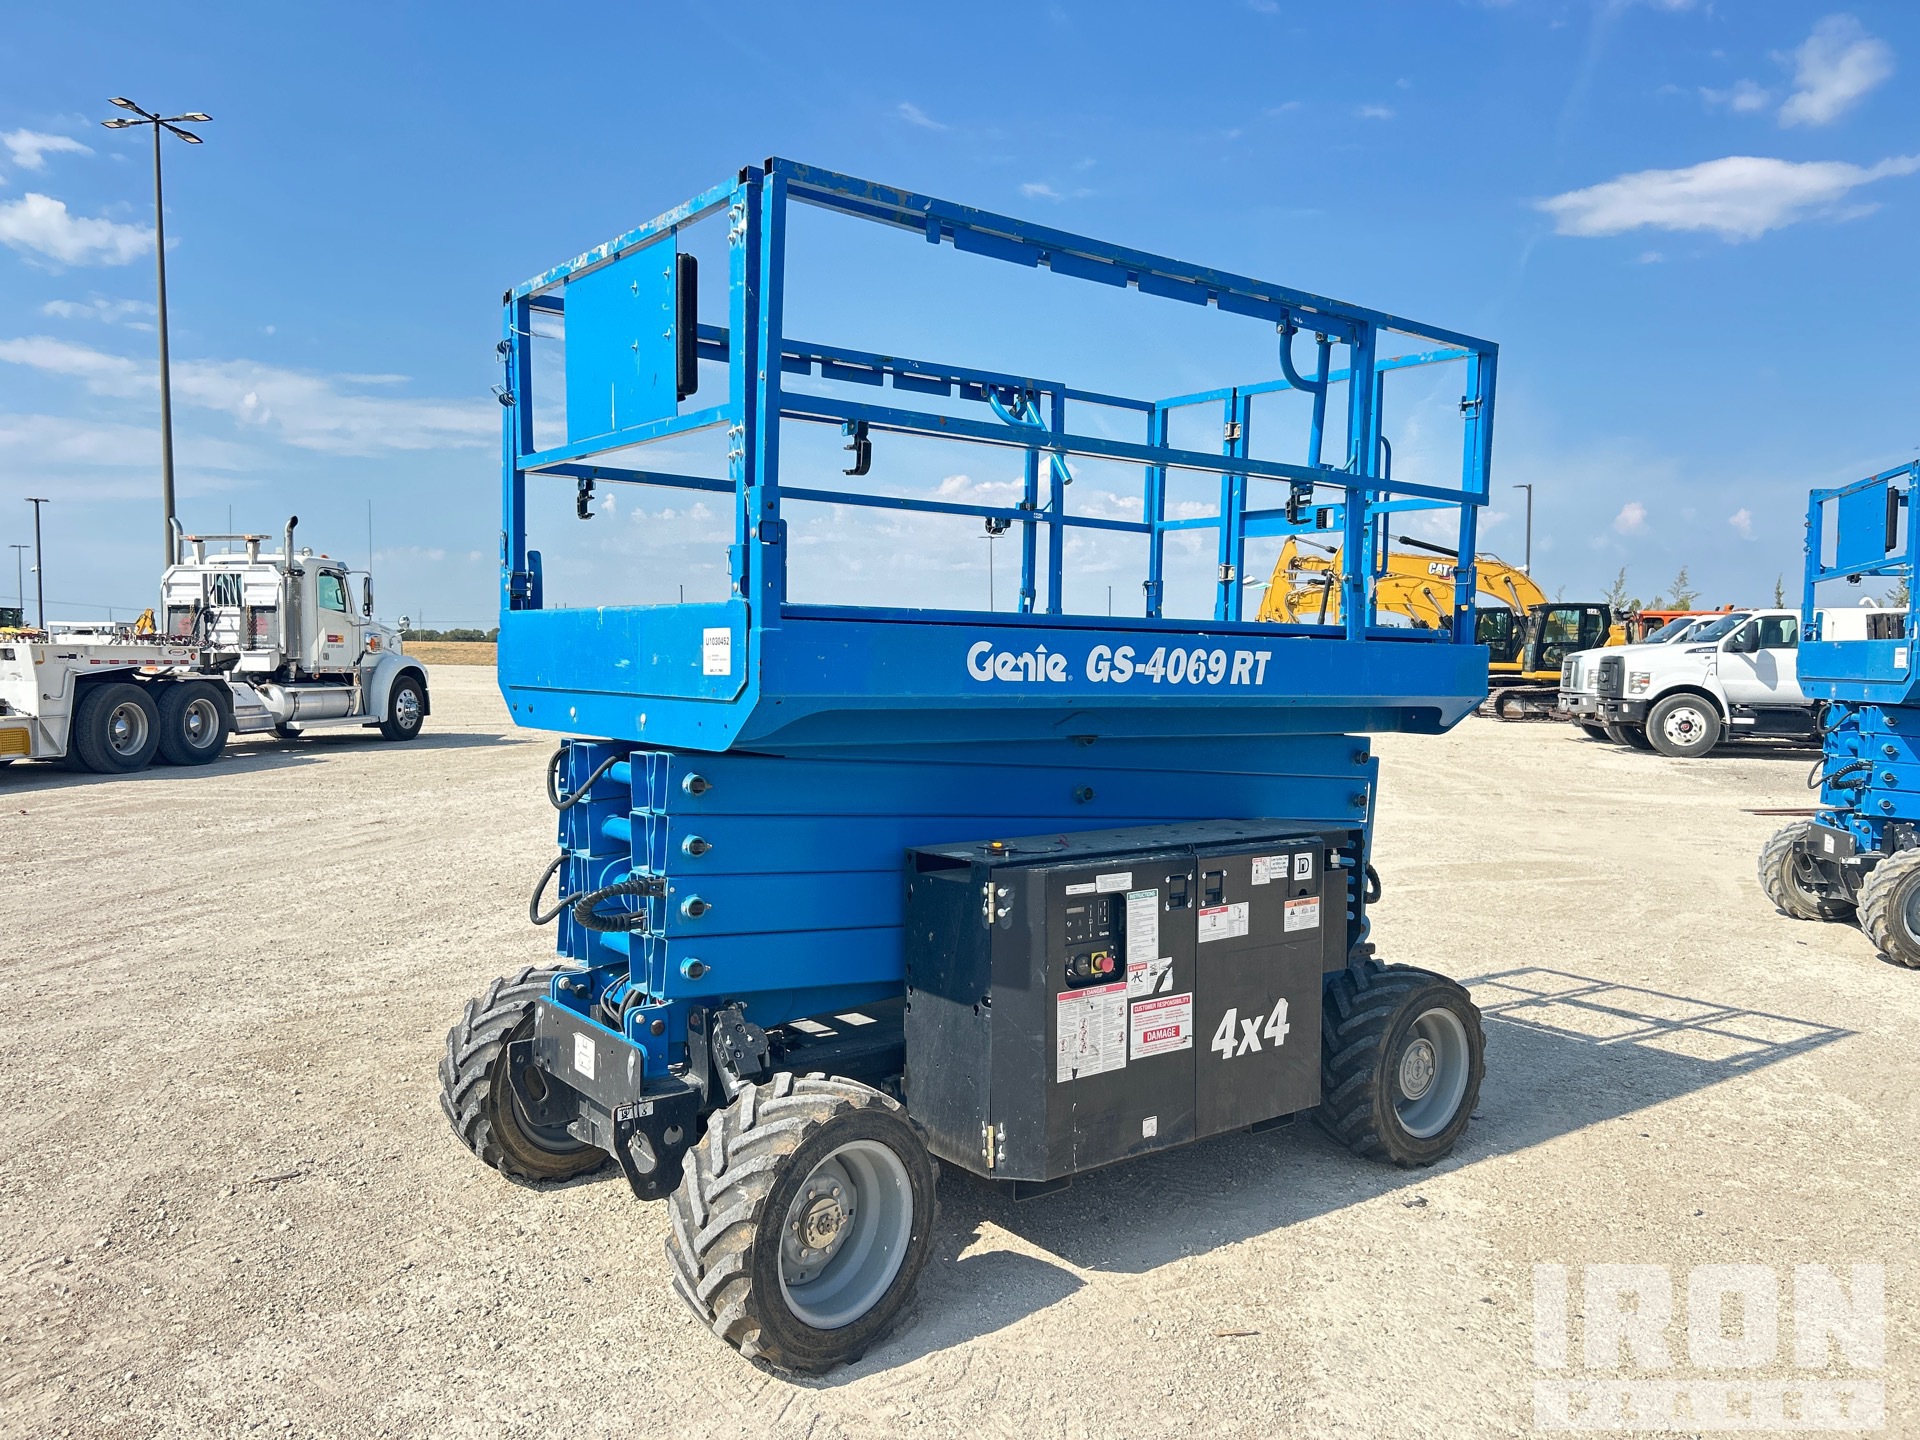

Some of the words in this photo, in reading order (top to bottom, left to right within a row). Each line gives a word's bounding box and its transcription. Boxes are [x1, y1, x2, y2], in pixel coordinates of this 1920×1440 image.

[1428, 562, 1450, 577] CAT
[705, 637, 730, 646] U1030452
[966, 641, 1067, 682] Genie
[1086, 645, 1228, 685] GS-4069
[1230, 650, 1273, 686] RT
[1129, 890, 1156, 899] INSTRUCTIONS
[1086, 987, 1107, 997] DANGER
[1134, 1002, 1157, 1013] CUSTOMER
[1156, 997, 1190, 1008] RESPONSIBILITY
[1147, 1027, 1176, 1041] DAMAGE
[1211, 997, 1291, 1060] 4x4
